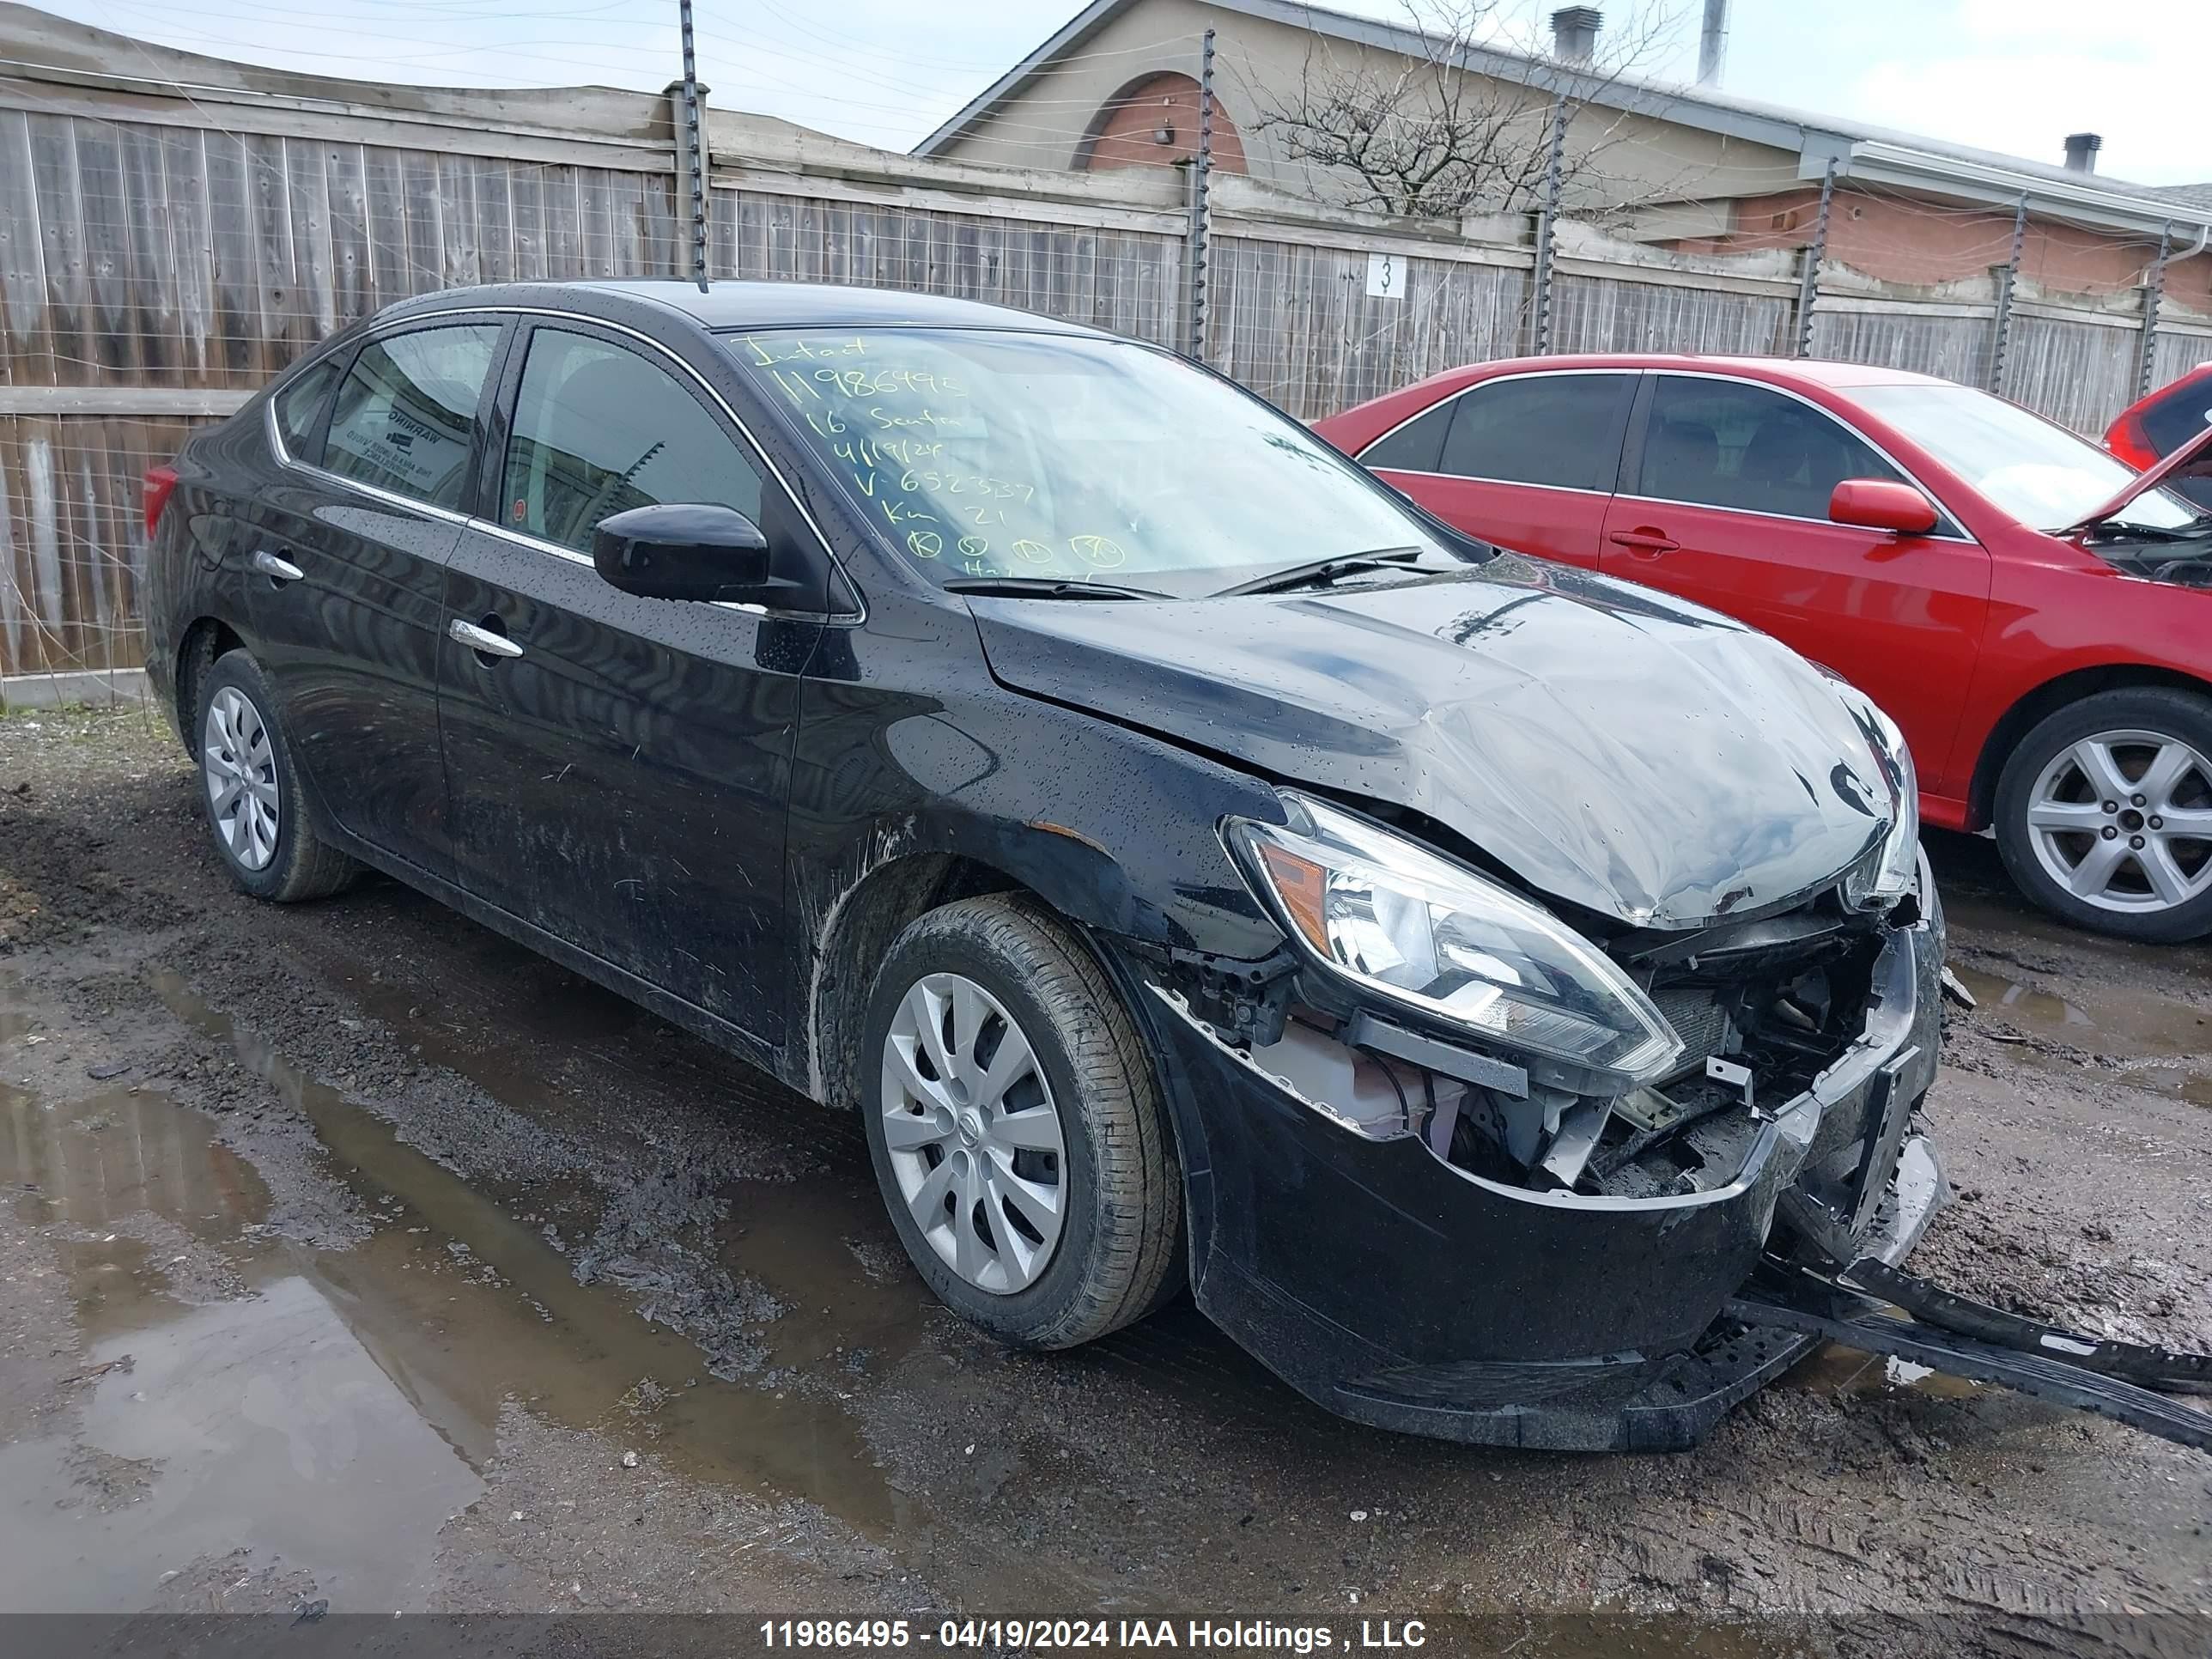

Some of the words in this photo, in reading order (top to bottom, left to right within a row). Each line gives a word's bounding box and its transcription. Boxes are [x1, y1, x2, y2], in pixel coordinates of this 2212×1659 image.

[1381, 262, 1391, 289] 3
[730, 336, 869, 366] Intact
[772, 368, 969, 404] 11986495
[805, 410, 846, 439] 16
[871, 407, 962, 429] Sentra
